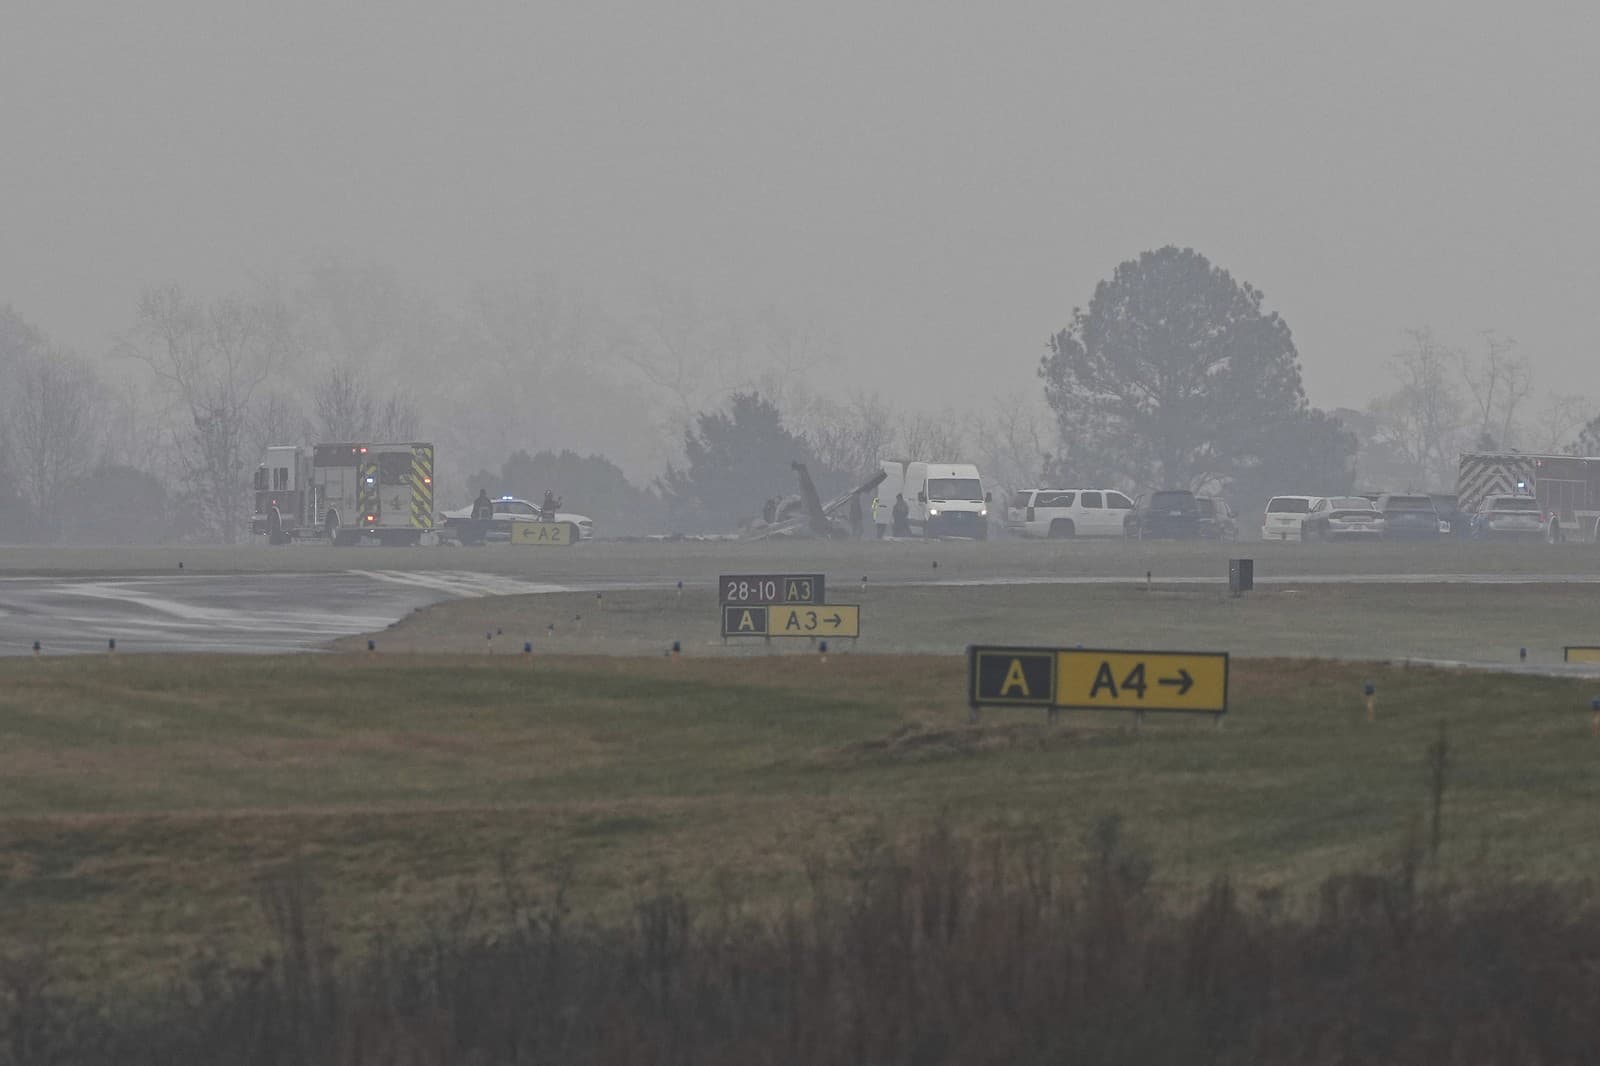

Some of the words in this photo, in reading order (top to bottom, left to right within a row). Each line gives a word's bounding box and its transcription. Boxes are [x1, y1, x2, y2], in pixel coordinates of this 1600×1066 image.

[538, 527, 561, 541] A2
[727, 581, 776, 601] 28-10
[788, 581, 811, 600] A3
[738, 610, 755, 631] A
[786, 611, 818, 631] A3
[1000, 658, 1030, 696] A
[1089, 660, 1148, 699] A4
